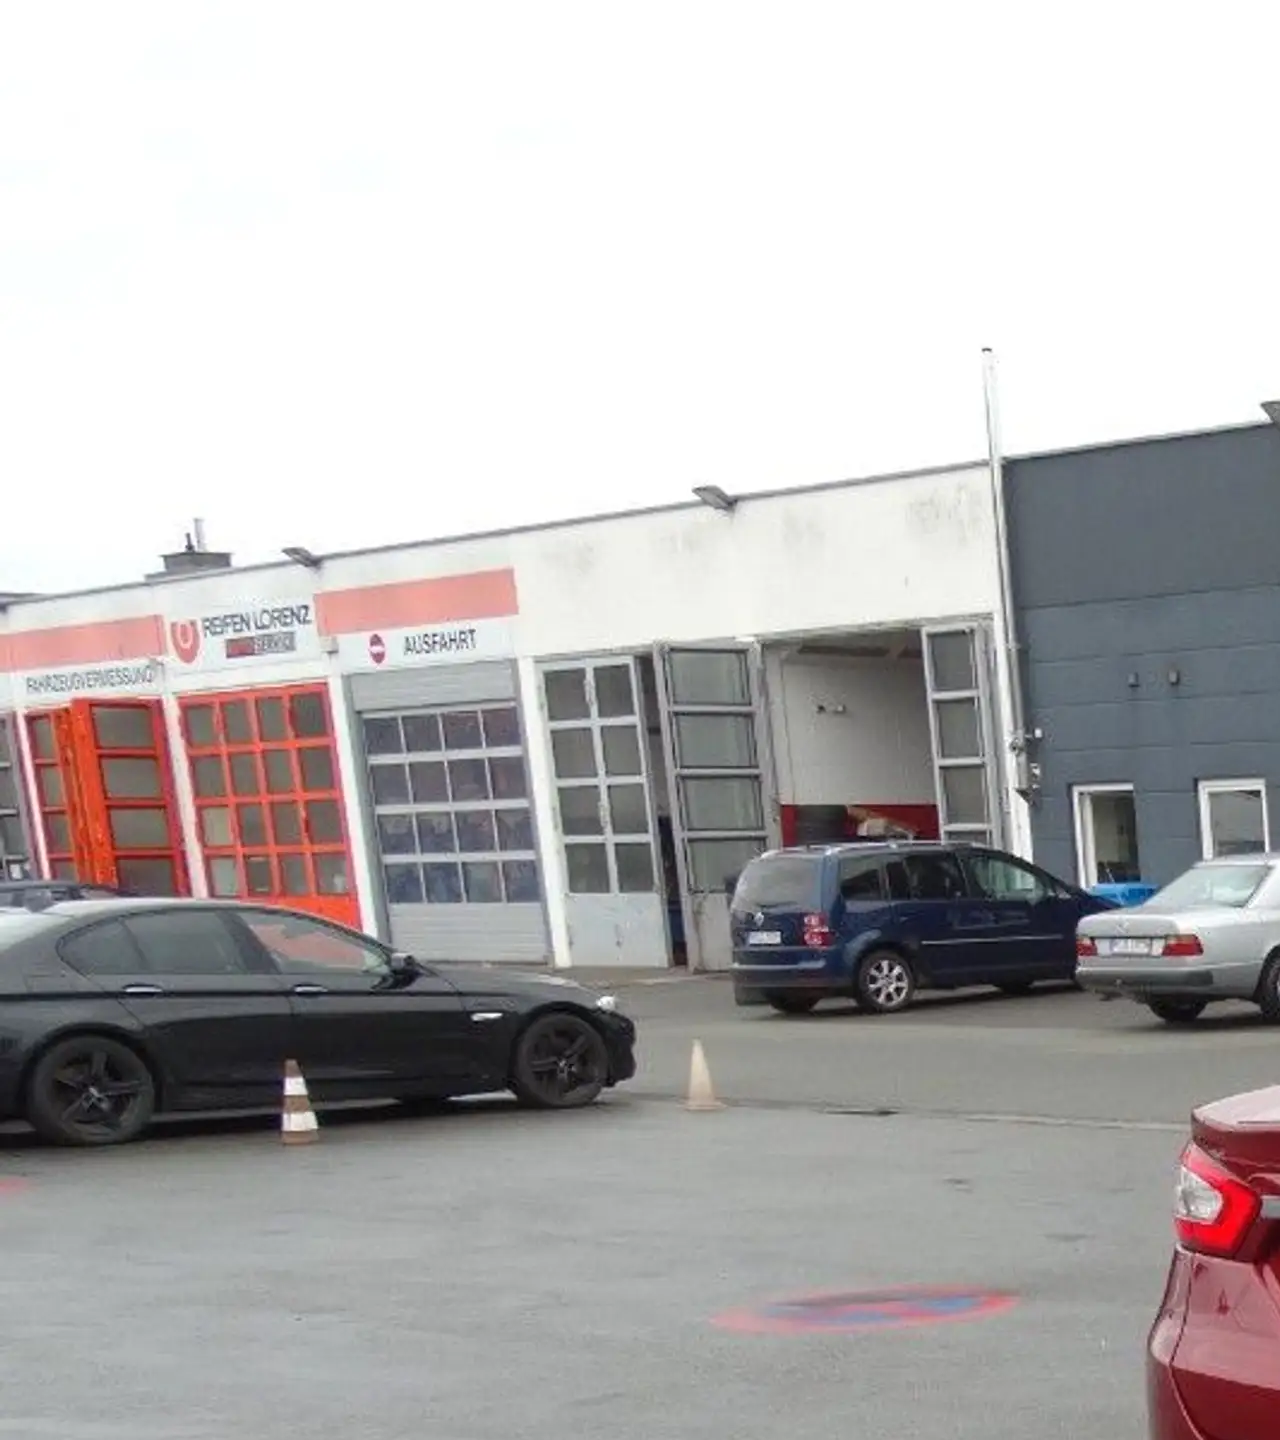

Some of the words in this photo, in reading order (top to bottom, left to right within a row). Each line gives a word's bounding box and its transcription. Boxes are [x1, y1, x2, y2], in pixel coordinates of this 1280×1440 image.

[202, 612, 250, 637] REIFEN
[253, 604, 312, 630] LORENZ
[403, 629, 477, 655] AUSFAHRT
